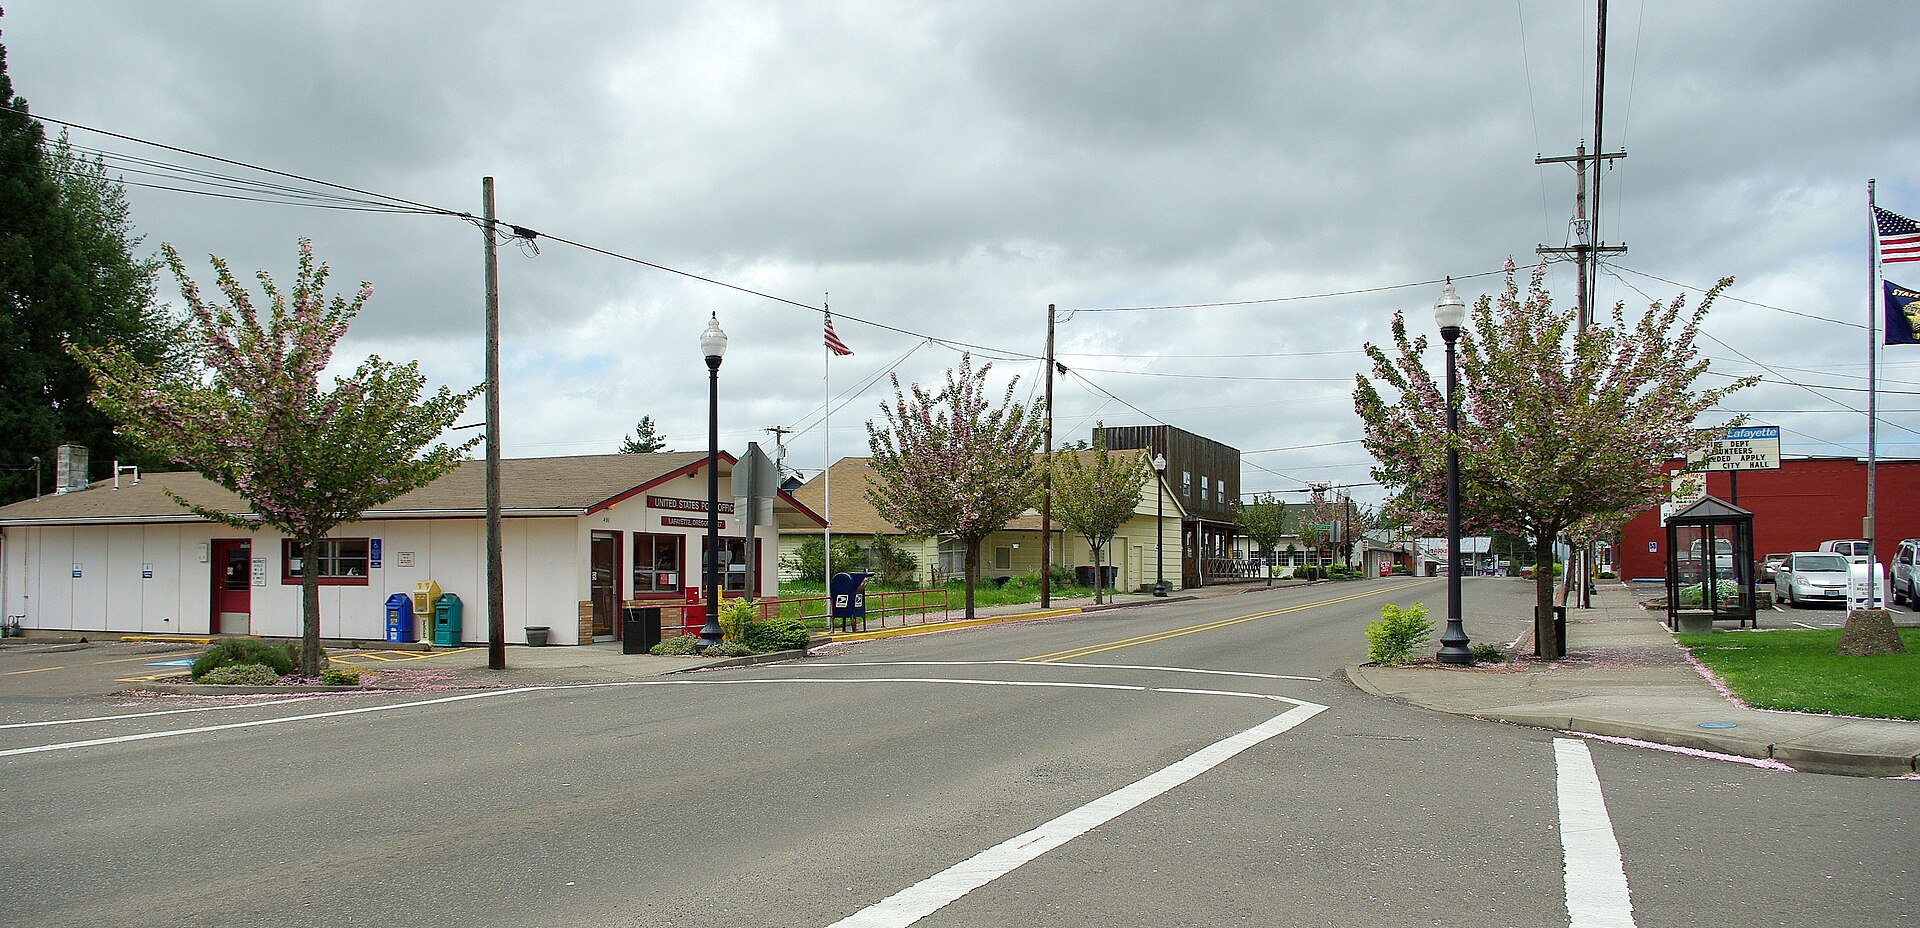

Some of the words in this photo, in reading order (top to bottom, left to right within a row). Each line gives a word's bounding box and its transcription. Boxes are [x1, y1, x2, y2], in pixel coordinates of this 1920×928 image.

[1727, 429, 1777, 439] Lafayette
[1741, 454, 1766, 462] APPLY
[655, 498, 677, 507] UNITED
[679, 500, 700, 510] STATES
[717, 503, 734, 513] OFFIC
